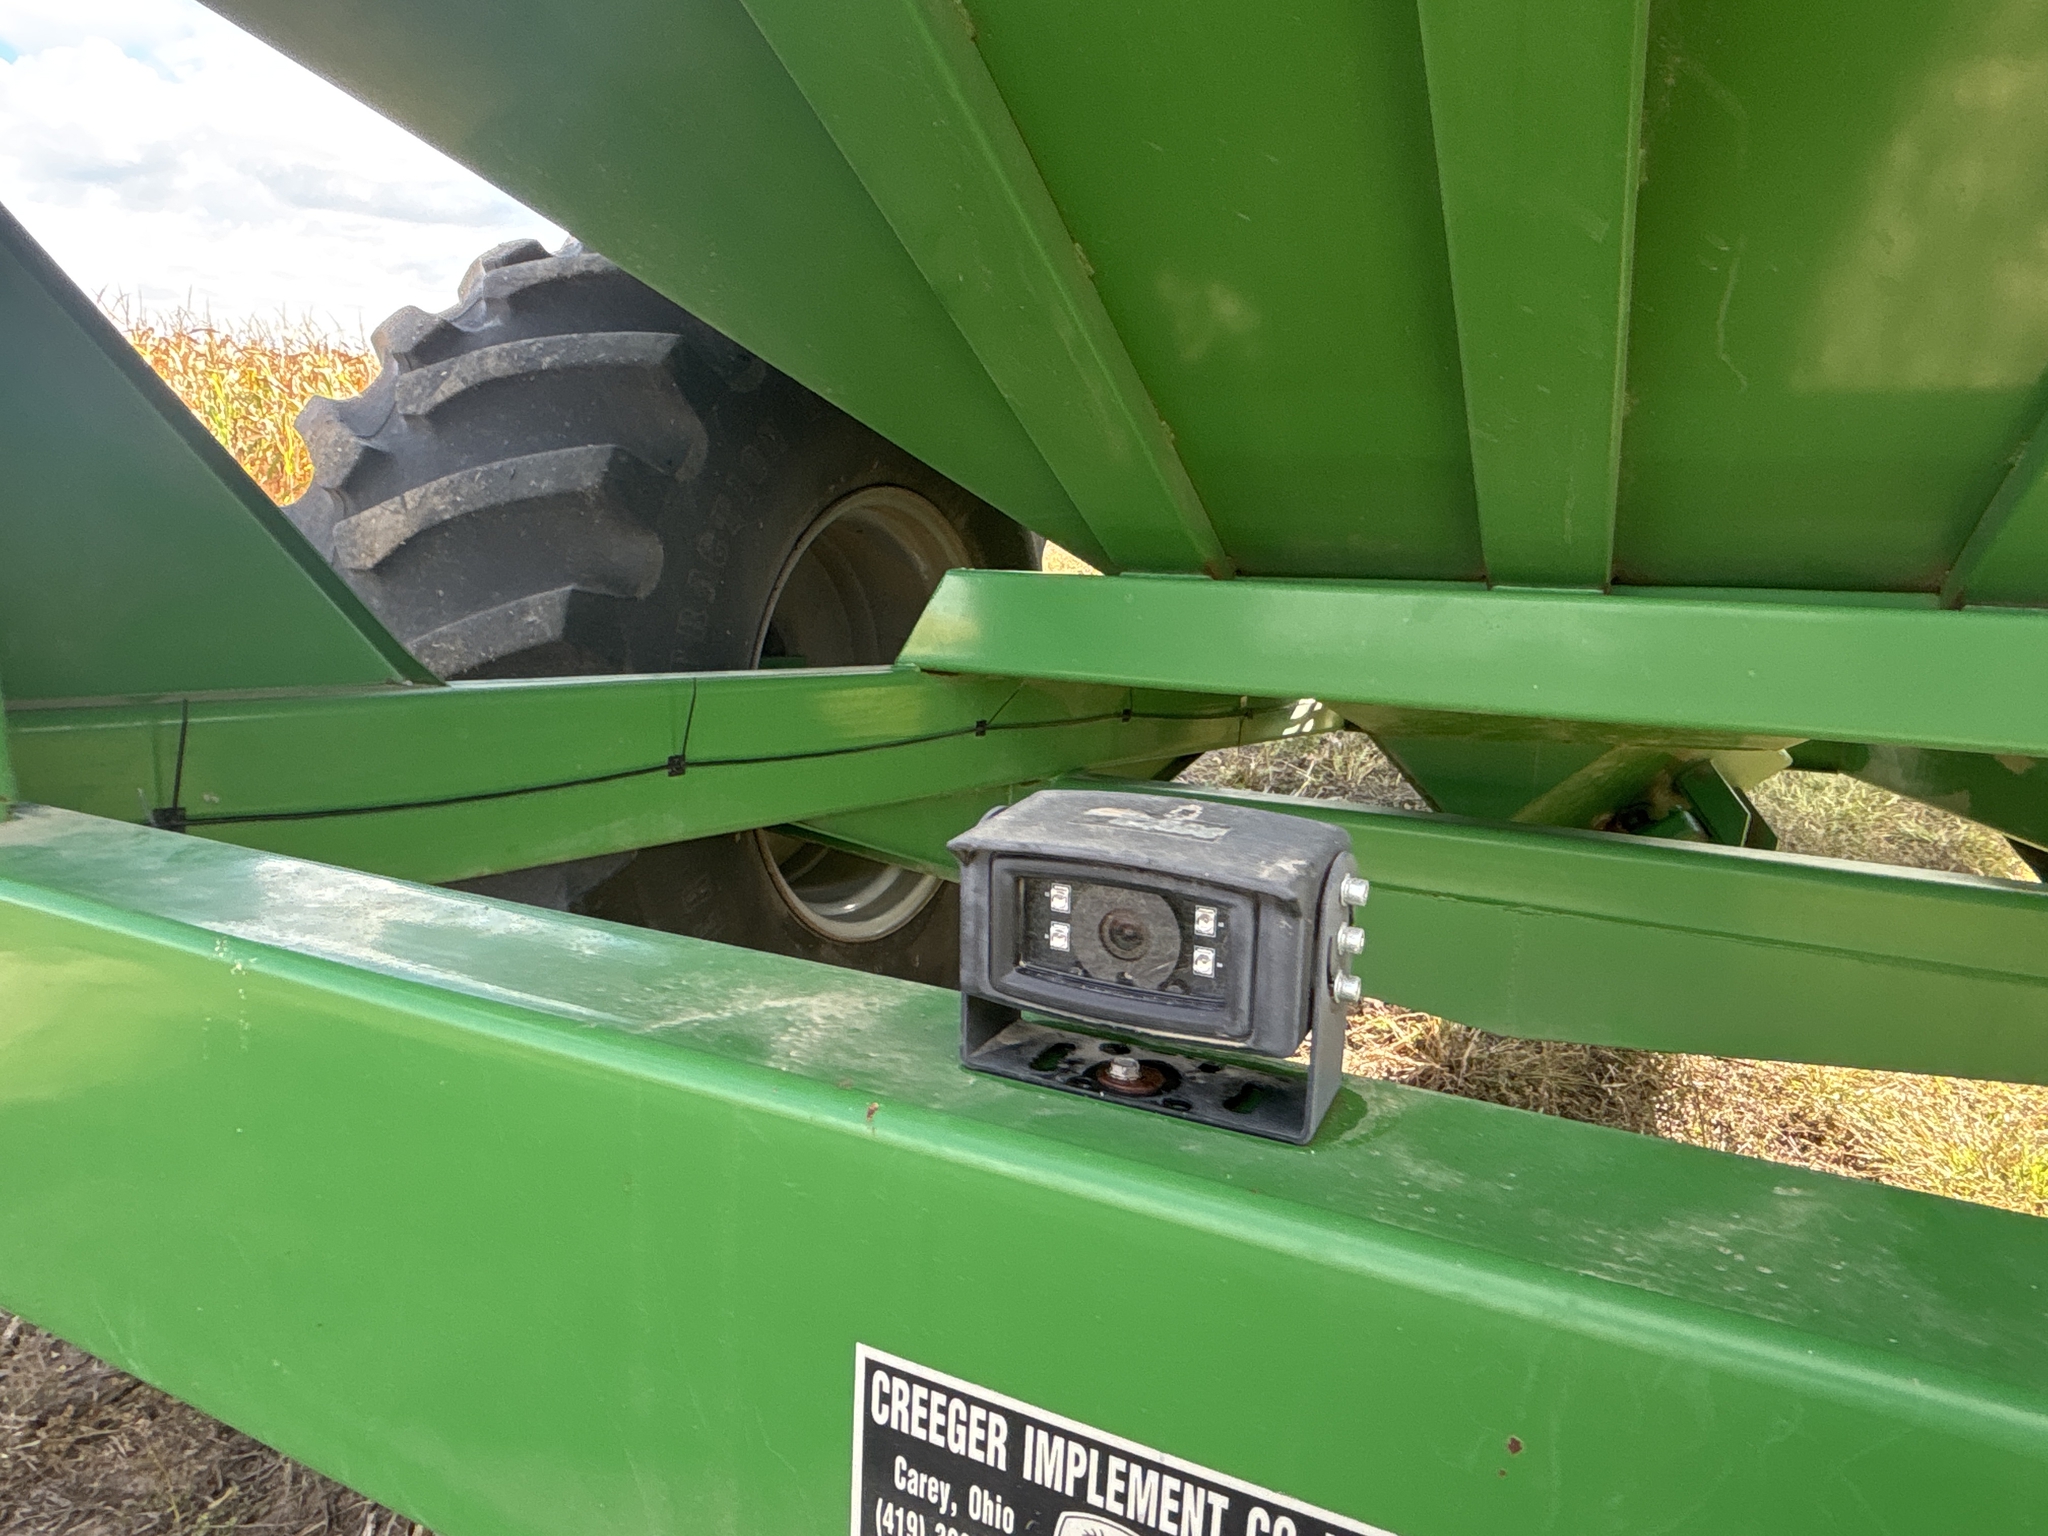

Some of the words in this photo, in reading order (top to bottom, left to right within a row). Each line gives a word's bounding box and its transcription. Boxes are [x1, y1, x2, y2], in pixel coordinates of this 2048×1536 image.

[871, 1369, 1008, 1472] CREEGER
[1022, 1424, 1230, 1536] IMPLEMENT
[894, 1455, 957, 1517] Carey,
[968, 1484, 1015, 1534] Ohio
